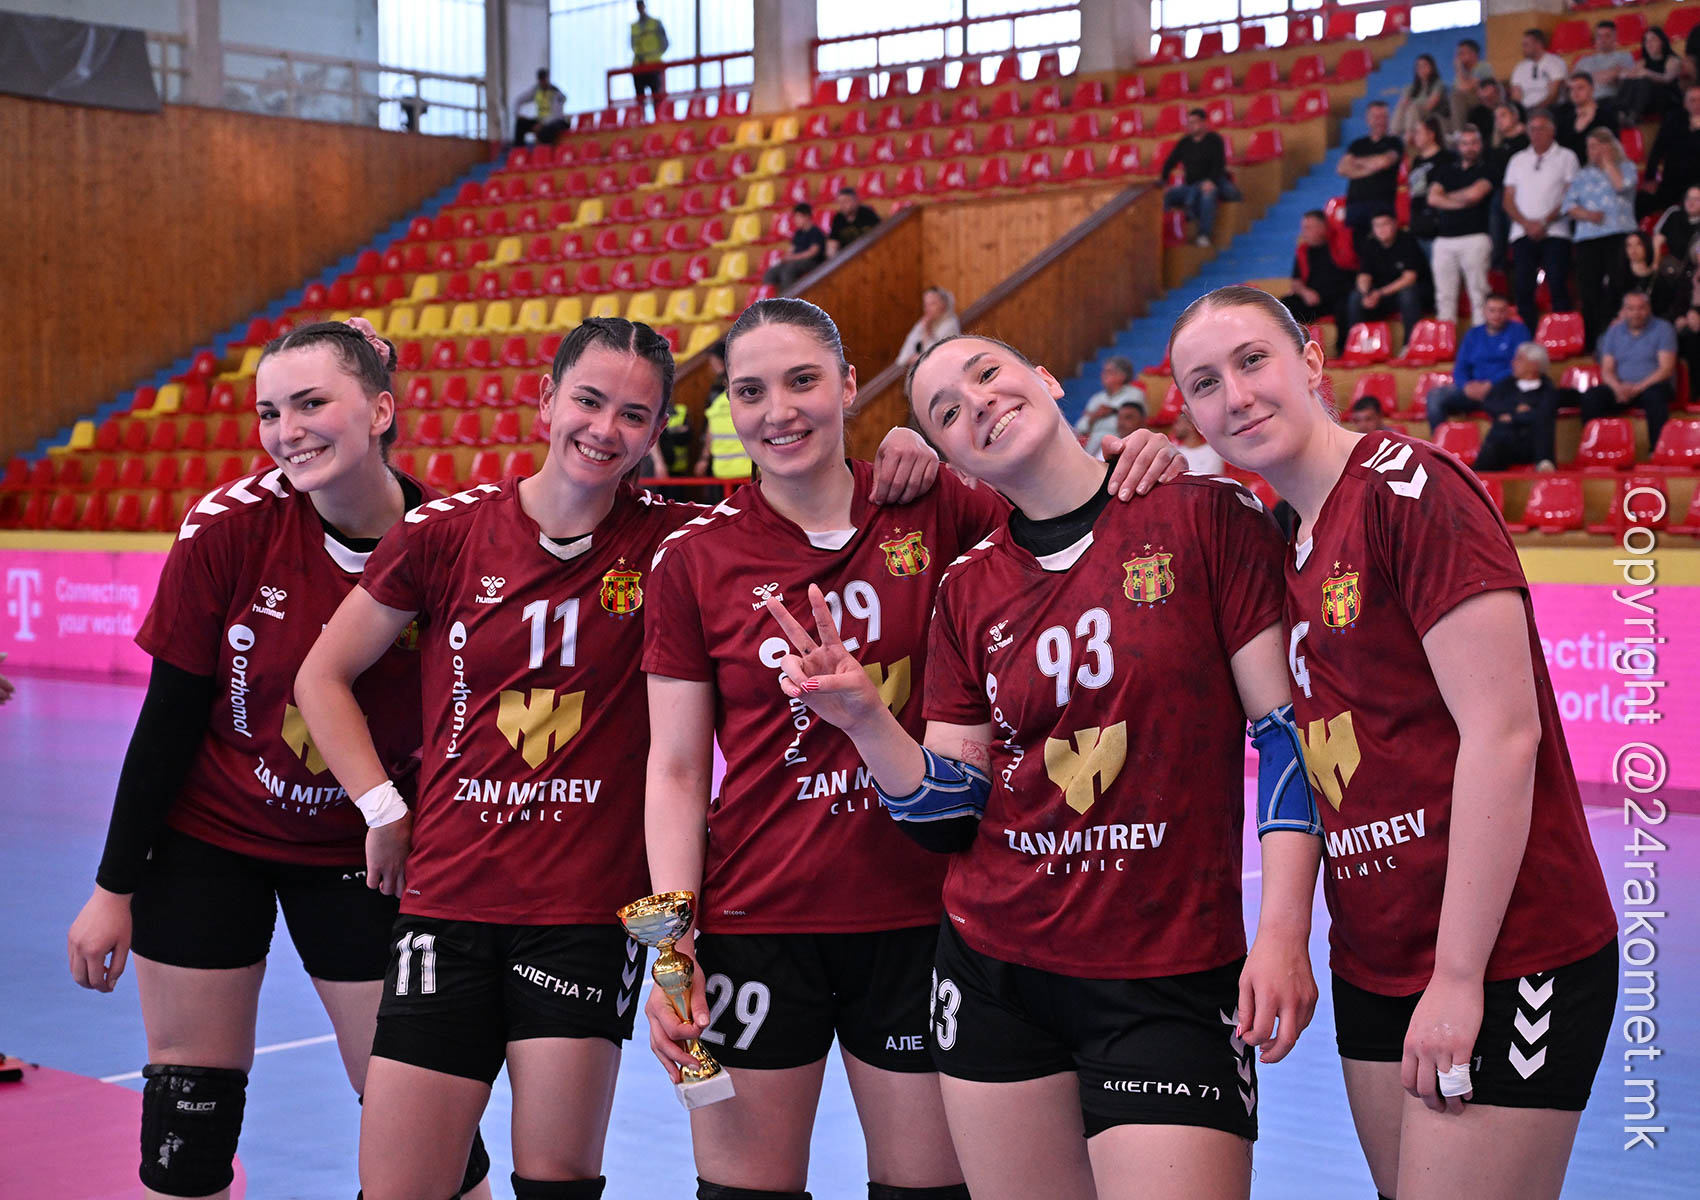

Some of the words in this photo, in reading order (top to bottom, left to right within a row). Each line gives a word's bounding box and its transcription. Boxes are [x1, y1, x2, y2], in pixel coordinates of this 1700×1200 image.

[56, 577, 139, 610] Connecting
[58, 613, 90, 638] your
[252, 603, 286, 620] hummel
[521, 597, 580, 670] 11
[1036, 606, 1115, 708] 93
[230, 655, 253, 738] orthomol
[254, 756, 286, 798] ZAN
[453, 778, 502, 801] ZAN
[506, 779, 602, 805] MITREV
[796, 769, 848, 801] ZAN
[479, 810, 563, 824] CLINIC
[1057, 821, 1168, 855] MITREV
[396, 931, 436, 996] 11
[512, 963, 580, 999] АЛЕГНА
[585, 986, 603, 1003] 71
[700, 973, 771, 1050] 29
[176, 1100, 217, 1112] SELECT
[1198, 1084, 1221, 1101] 71
